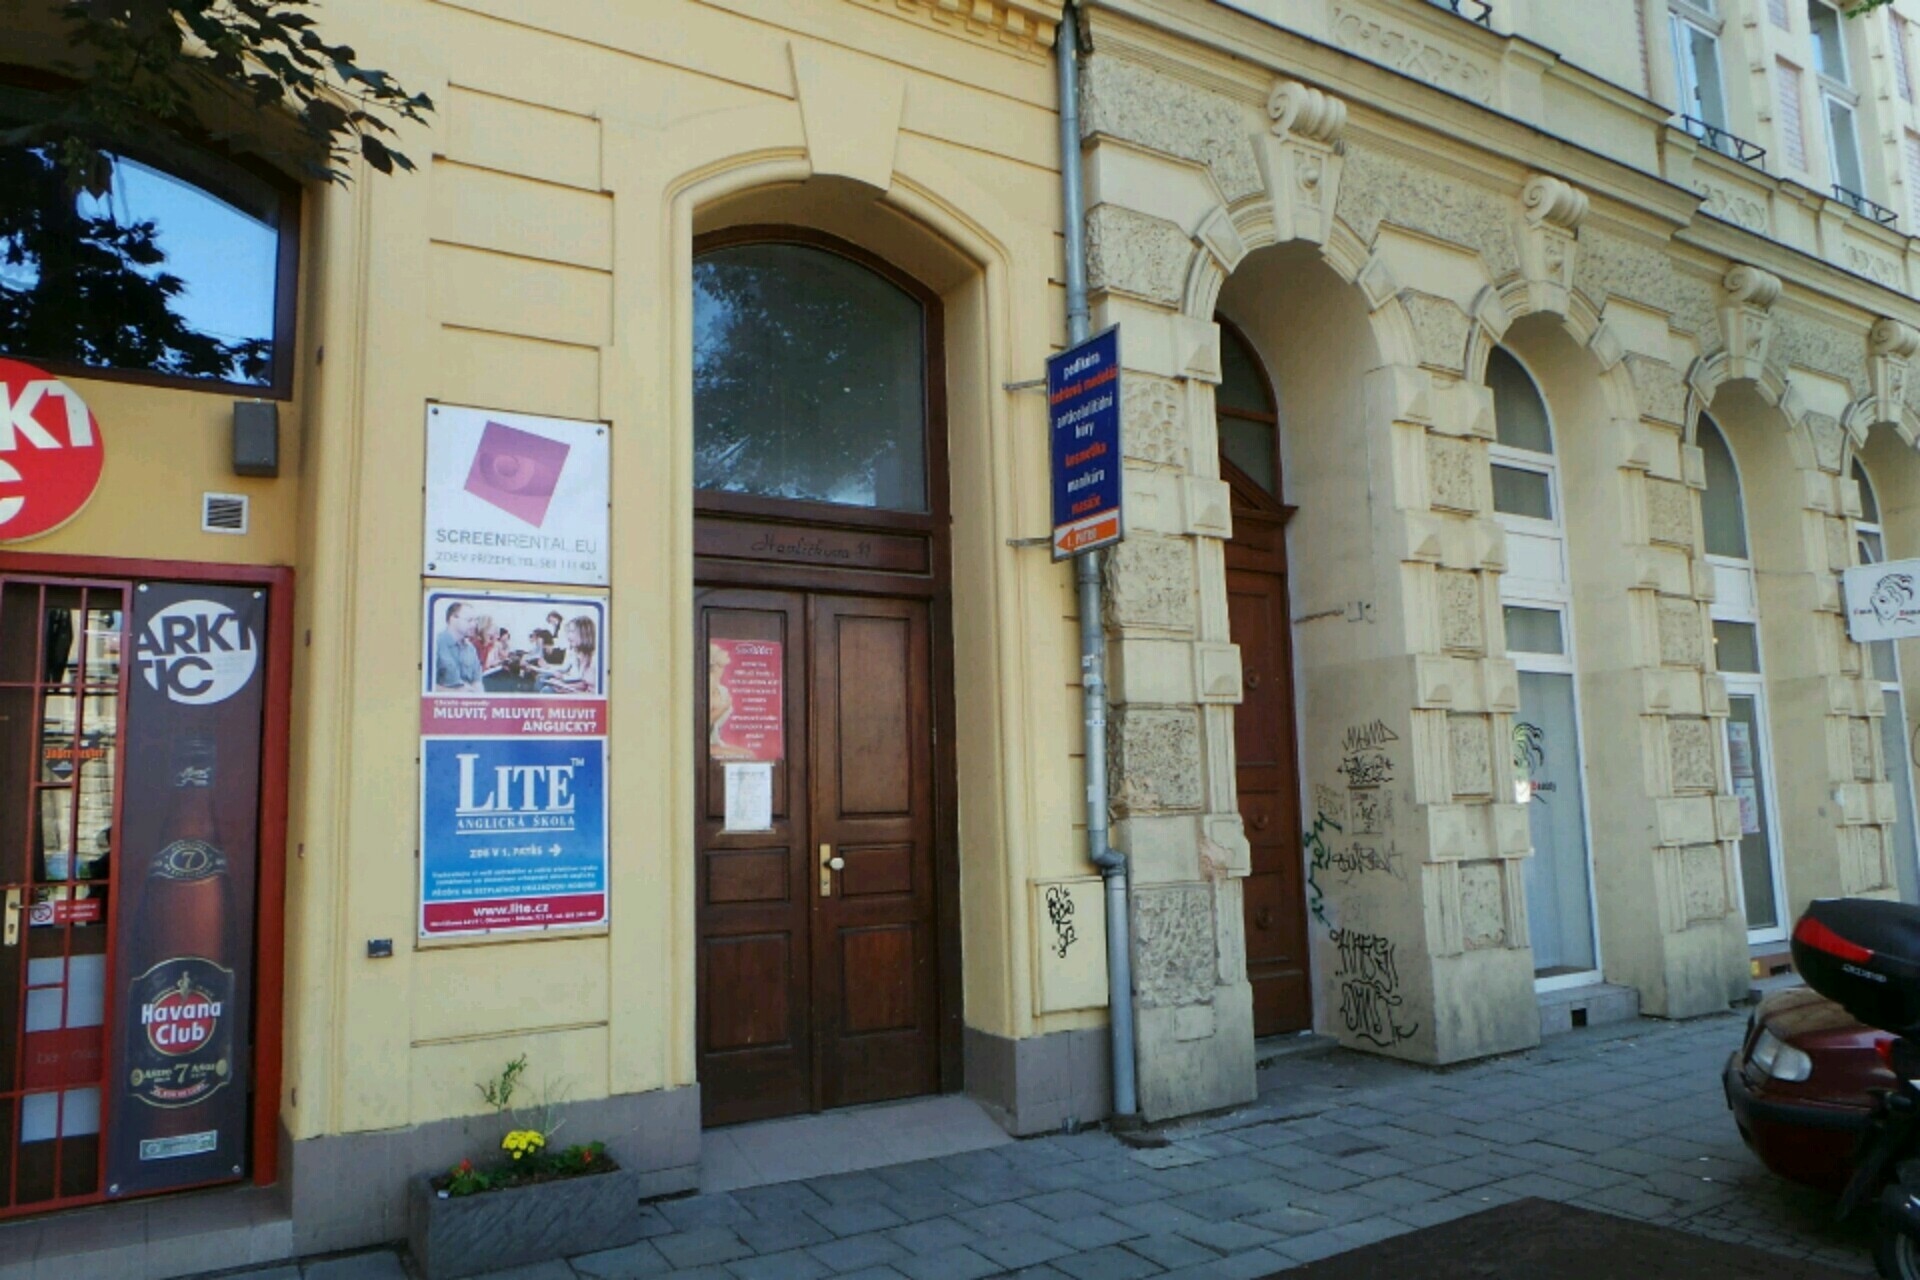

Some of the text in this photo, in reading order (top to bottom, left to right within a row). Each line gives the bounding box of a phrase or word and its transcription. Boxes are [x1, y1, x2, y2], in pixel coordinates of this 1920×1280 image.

[434, 707, 597, 720] MLUVIT, MLUVIT, MLUVIT
[522, 721, 597, 732] ANGLICKY?
[457, 814, 575, 829] ANGLICKÁ ŠKOLA
[474, 903, 549, 917] www.lite.cz
[142, 1002, 222, 1025] Havana
[156, 1021, 205, 1045] Club
[174, 1063, 190, 1083] 7
